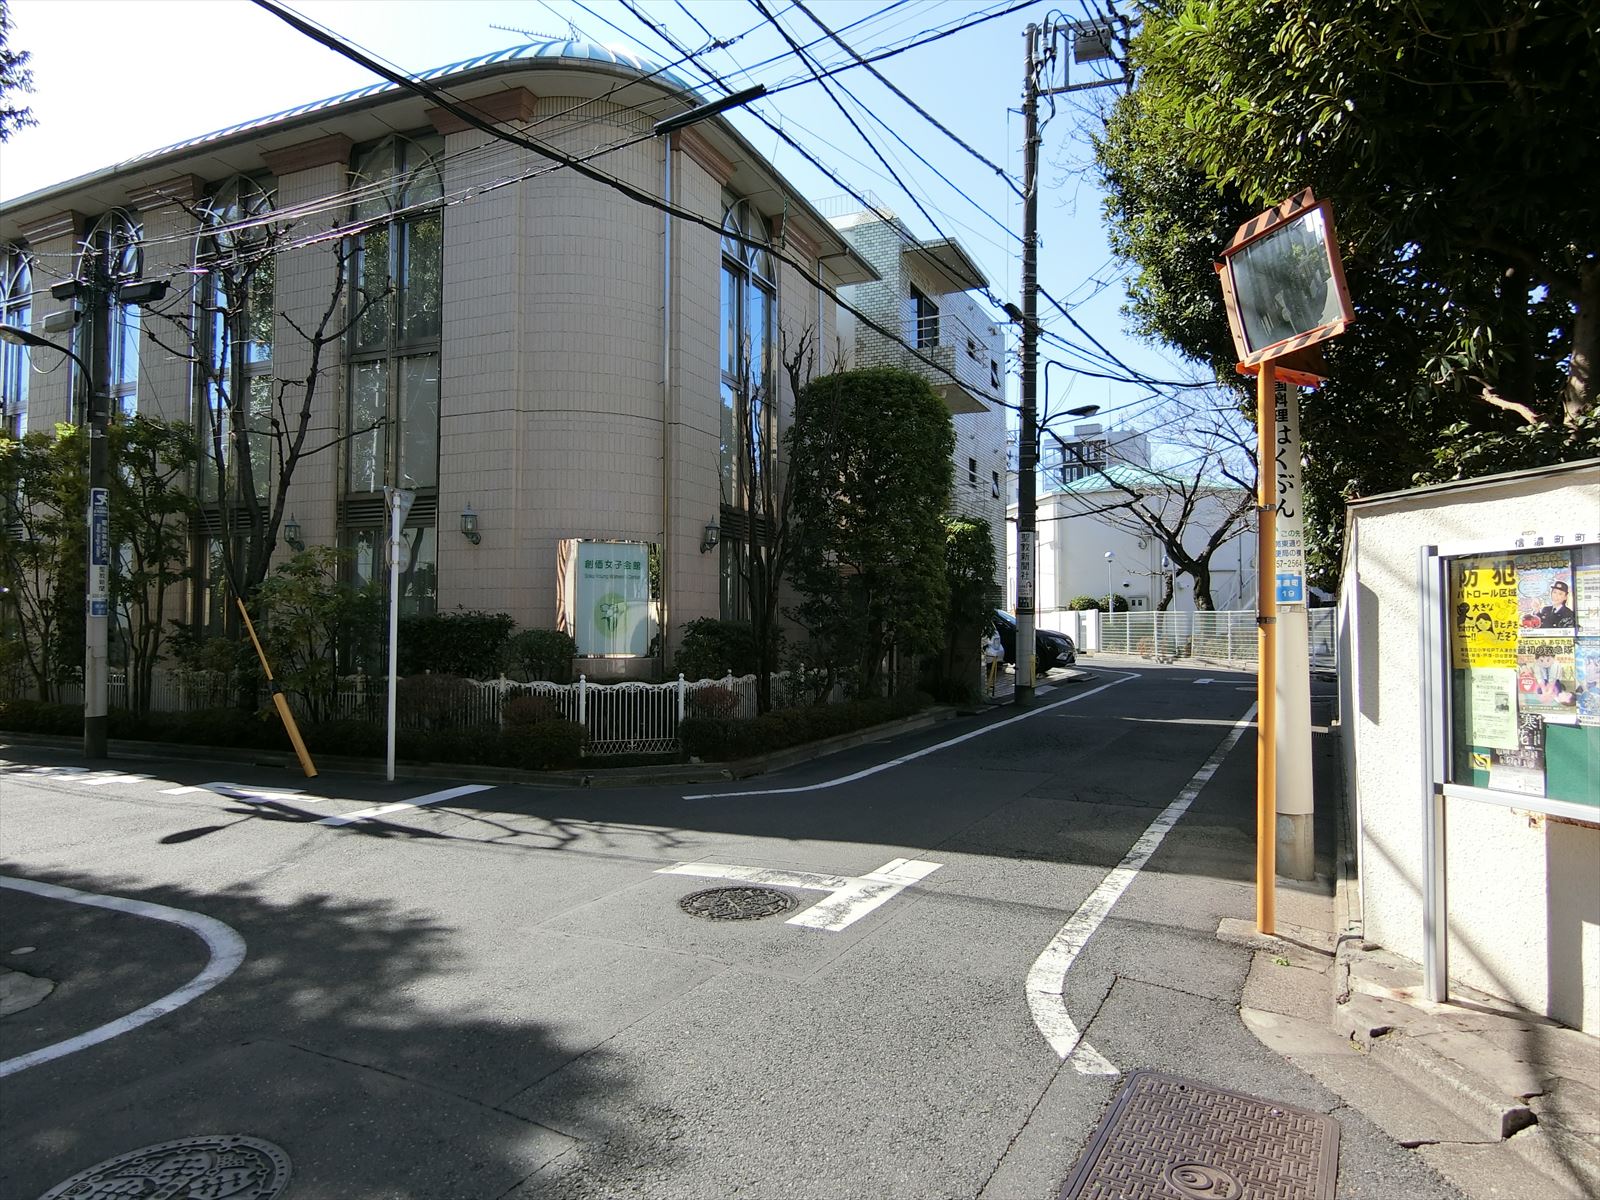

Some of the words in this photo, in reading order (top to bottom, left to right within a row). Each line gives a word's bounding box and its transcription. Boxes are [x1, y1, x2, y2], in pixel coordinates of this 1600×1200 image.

[1020, 533, 1030, 580] 聖教新聞社
[584, 560, 641, 570] 創価女子会館
[1459, 560, 1516, 588] 防犯
[1457, 588, 1517, 598] パトロール区域
[1472, 603, 1494, 612] 大きな
[1496, 631, 1518, 641] だそう
[1518, 645, 1574, 655] 最初の救急隊
